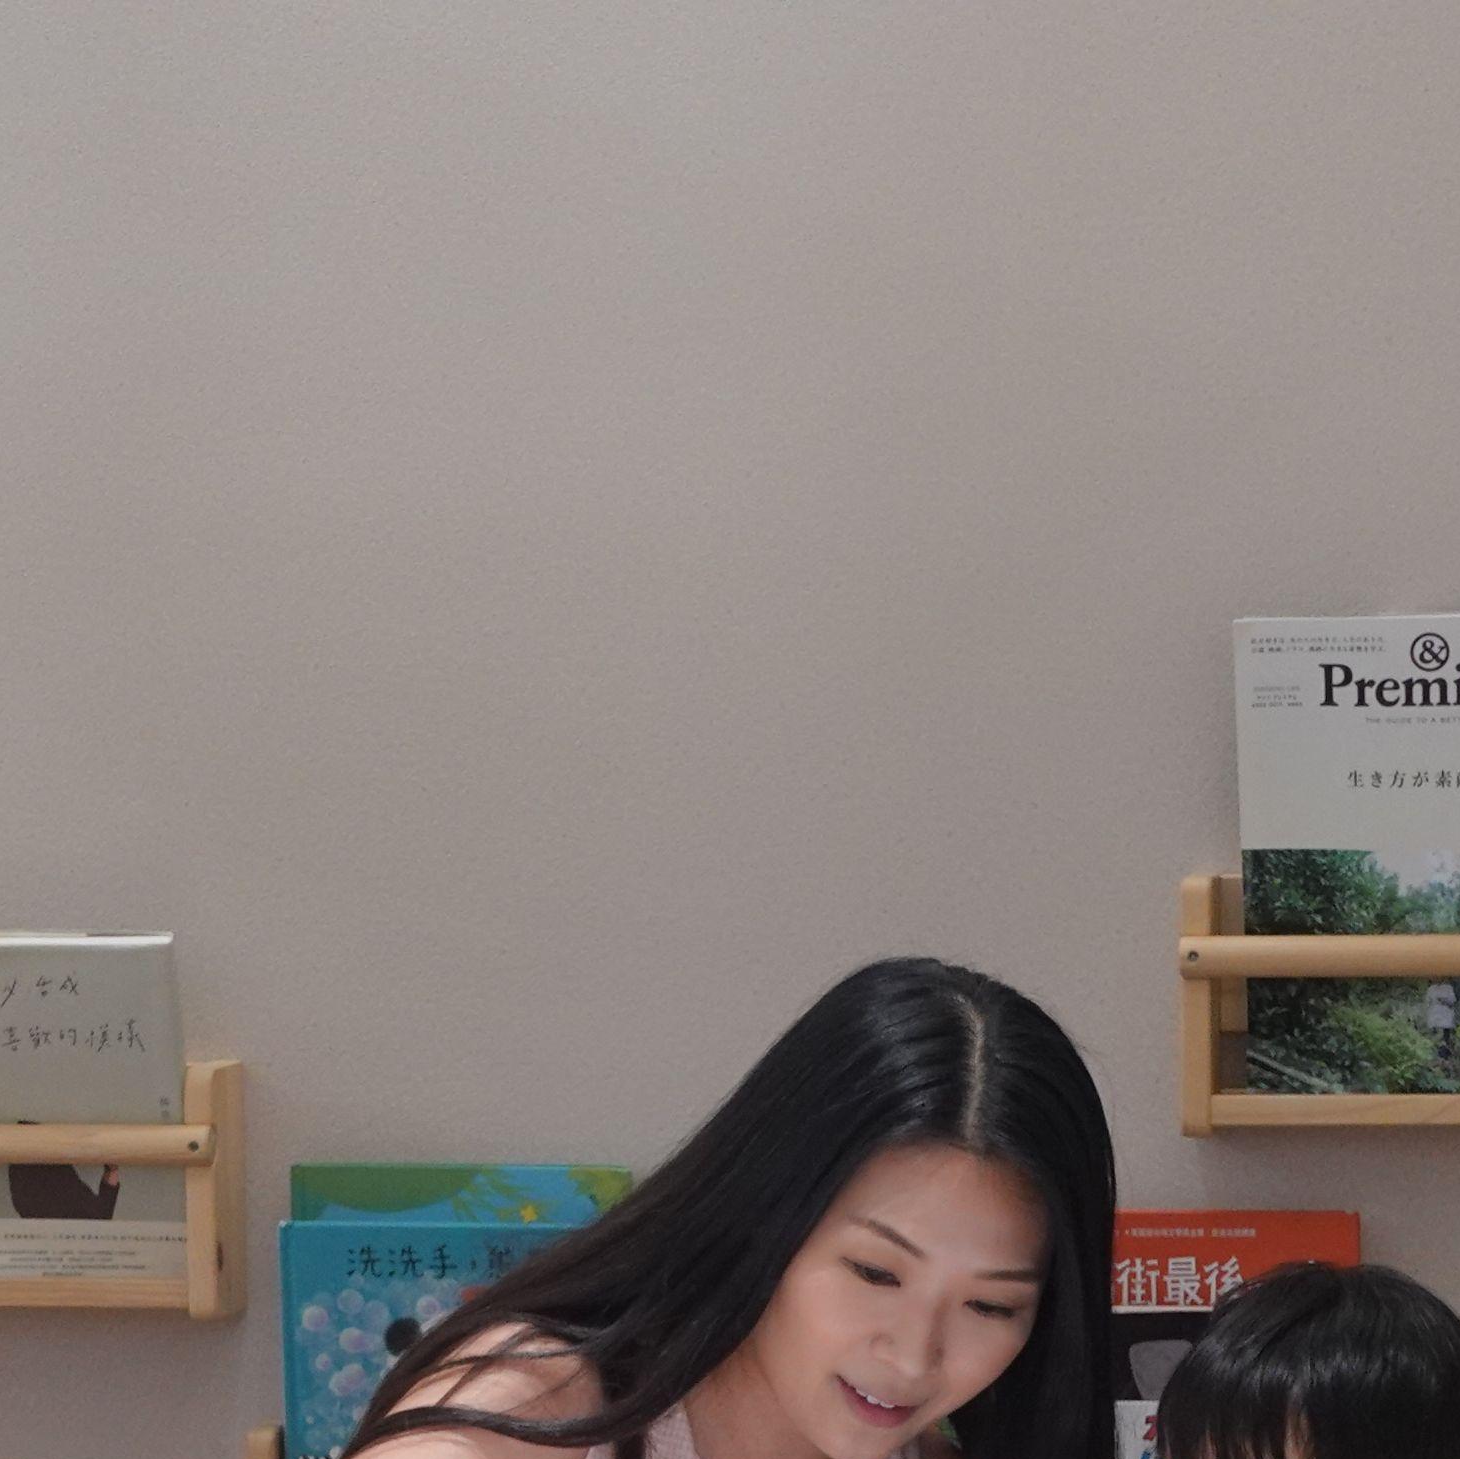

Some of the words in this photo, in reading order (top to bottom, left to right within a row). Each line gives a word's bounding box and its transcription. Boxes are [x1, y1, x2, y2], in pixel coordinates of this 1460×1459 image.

[1414, 635, 1449, 668] &
[1115, 1256, 1244, 1307] 街最後
